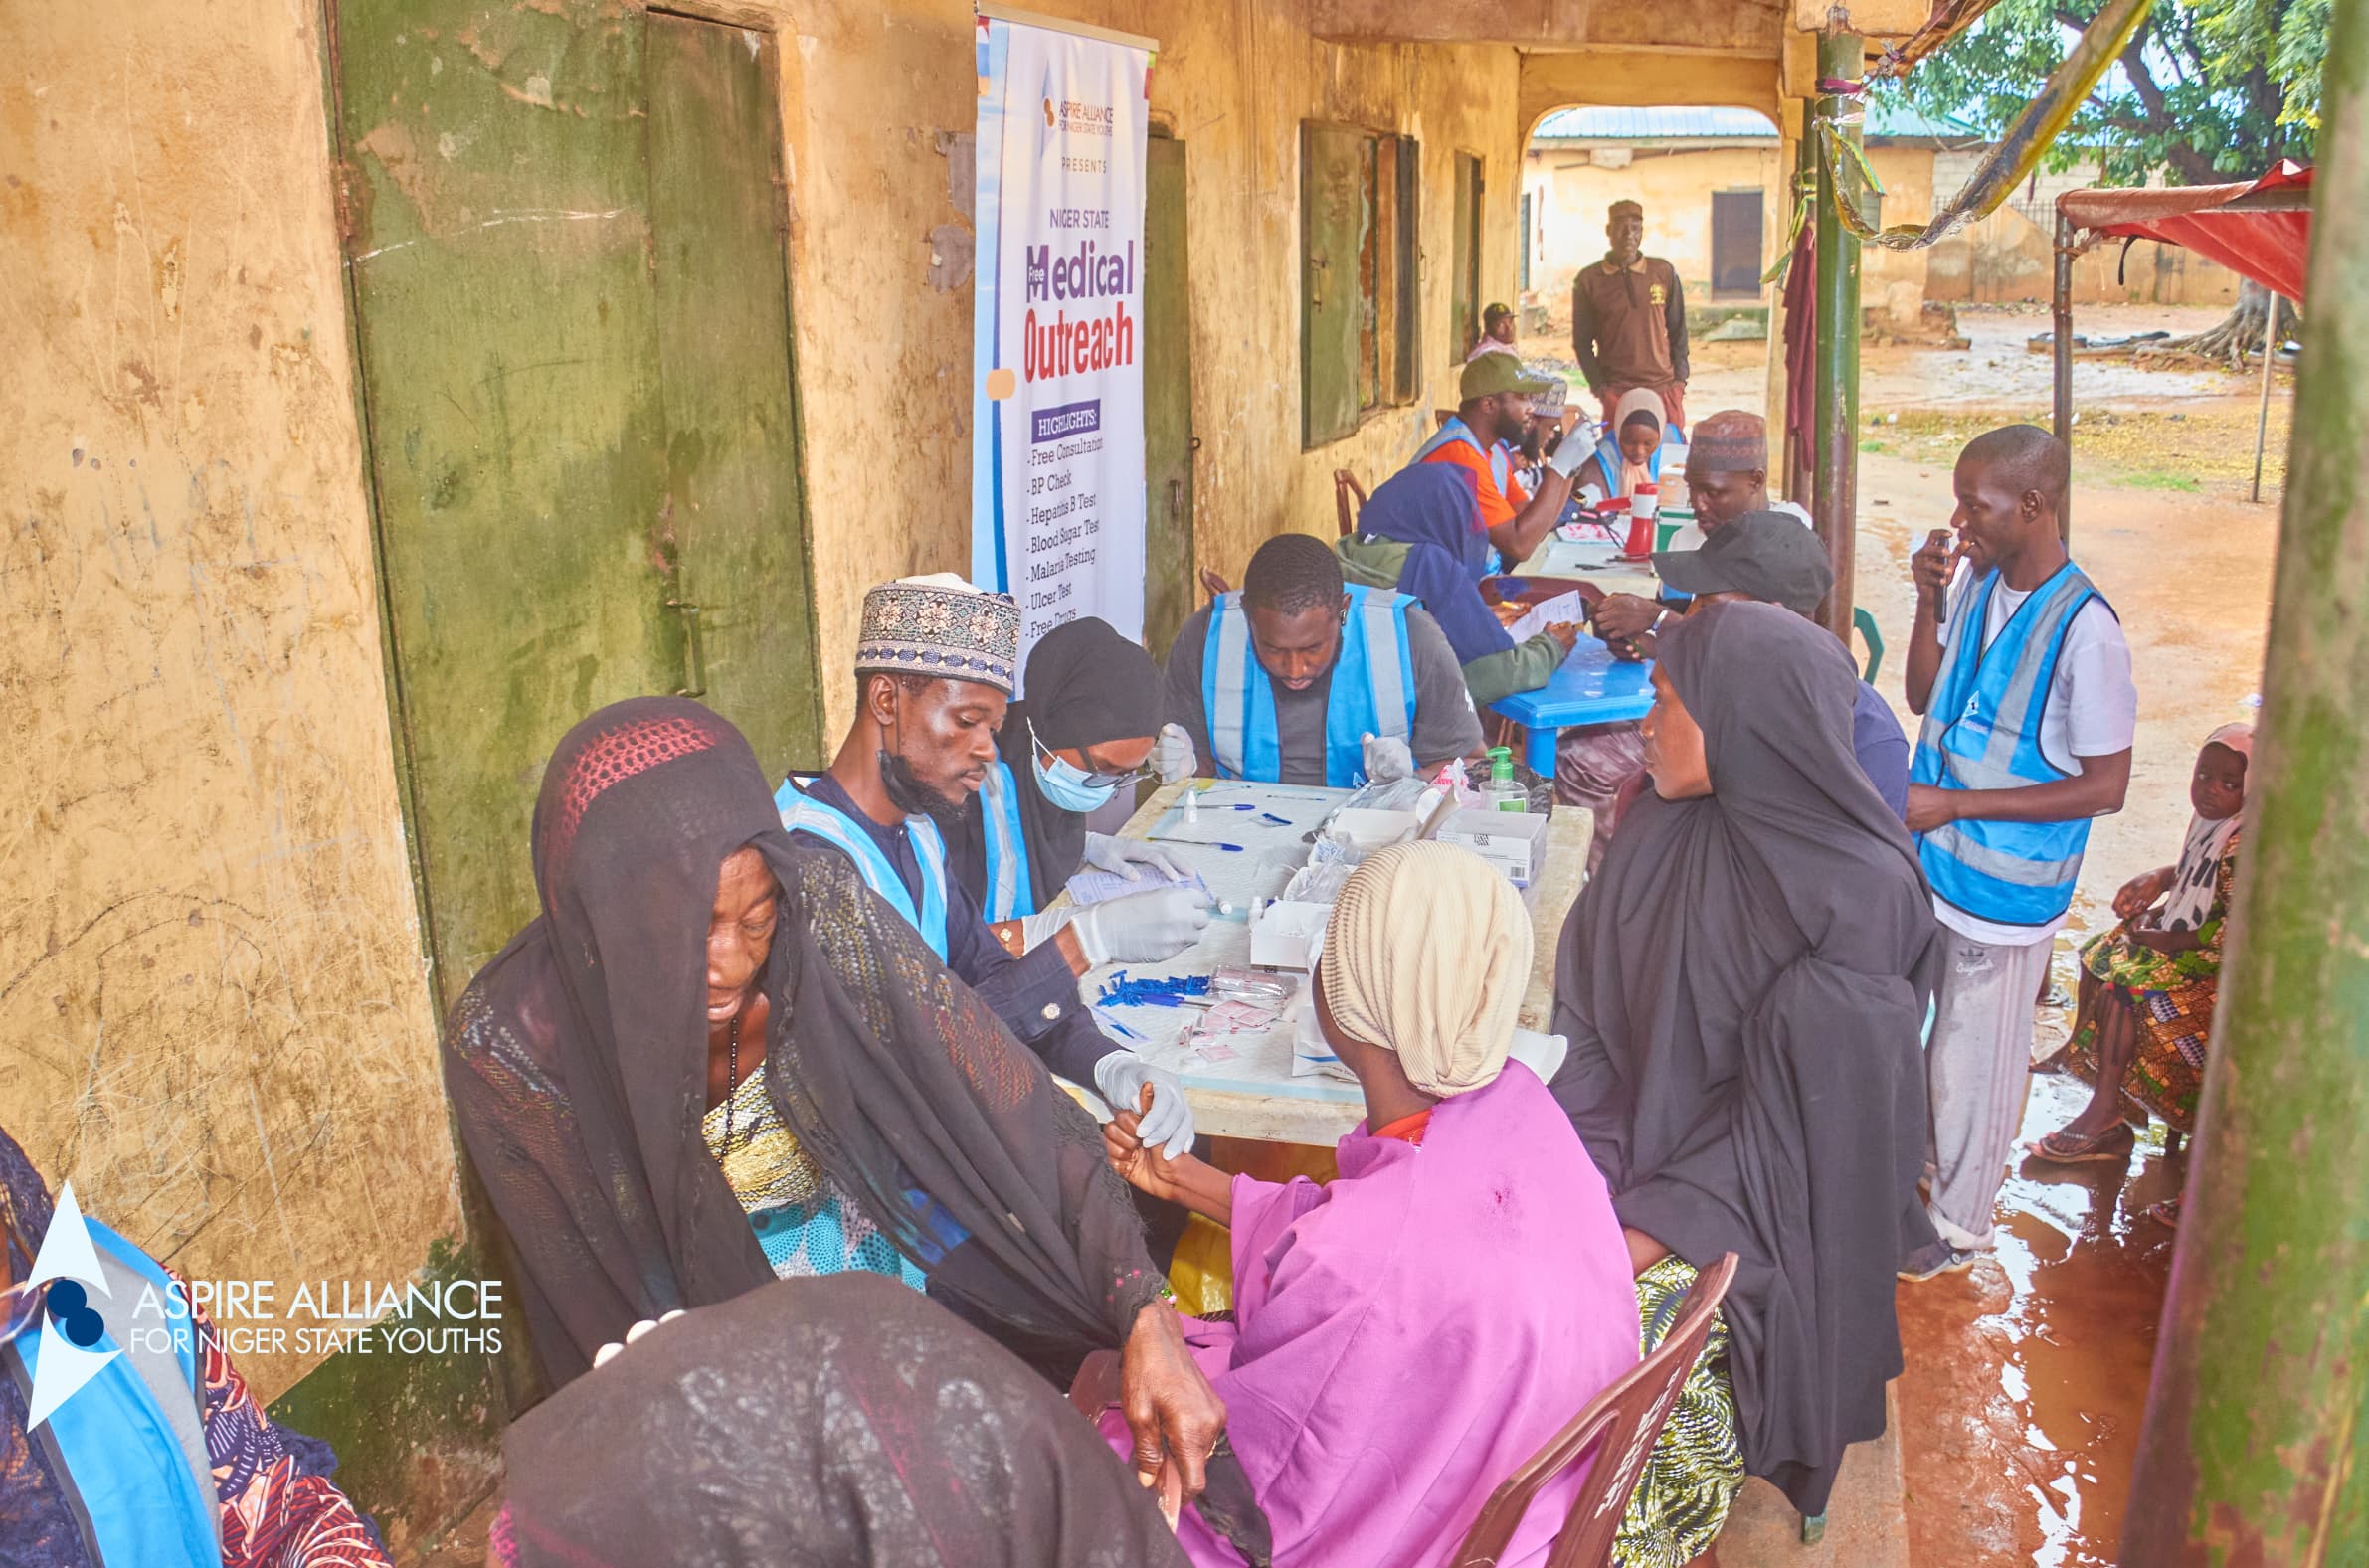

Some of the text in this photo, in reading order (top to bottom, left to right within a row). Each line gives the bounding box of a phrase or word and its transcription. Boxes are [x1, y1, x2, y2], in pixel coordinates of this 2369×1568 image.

[1059, 100, 1113, 124] ASPIRE ALLIANCE
[1061, 156, 1106, 174] PRESENTS
[1050, 208, 1109, 229] NIGER STATE
[1026, 240, 1134, 303] Medical
[1028, 266, 1044, 282] Free
[1024, 301, 1133, 384] Outreach
[1031, 448, 1054, 466] Free
[1031, 469, 1072, 495] BP Check
[1070, 495, 1076, 512] B
[1078, 493, 1096, 510] Test
[1031, 530, 1059, 554] Blood
[1060, 525, 1082, 545] Sugar
[1030, 547, 1096, 582] Malaria Testing
[1030, 582, 1072, 610] Ulcer Test
[1030, 620, 1053, 638] Free
